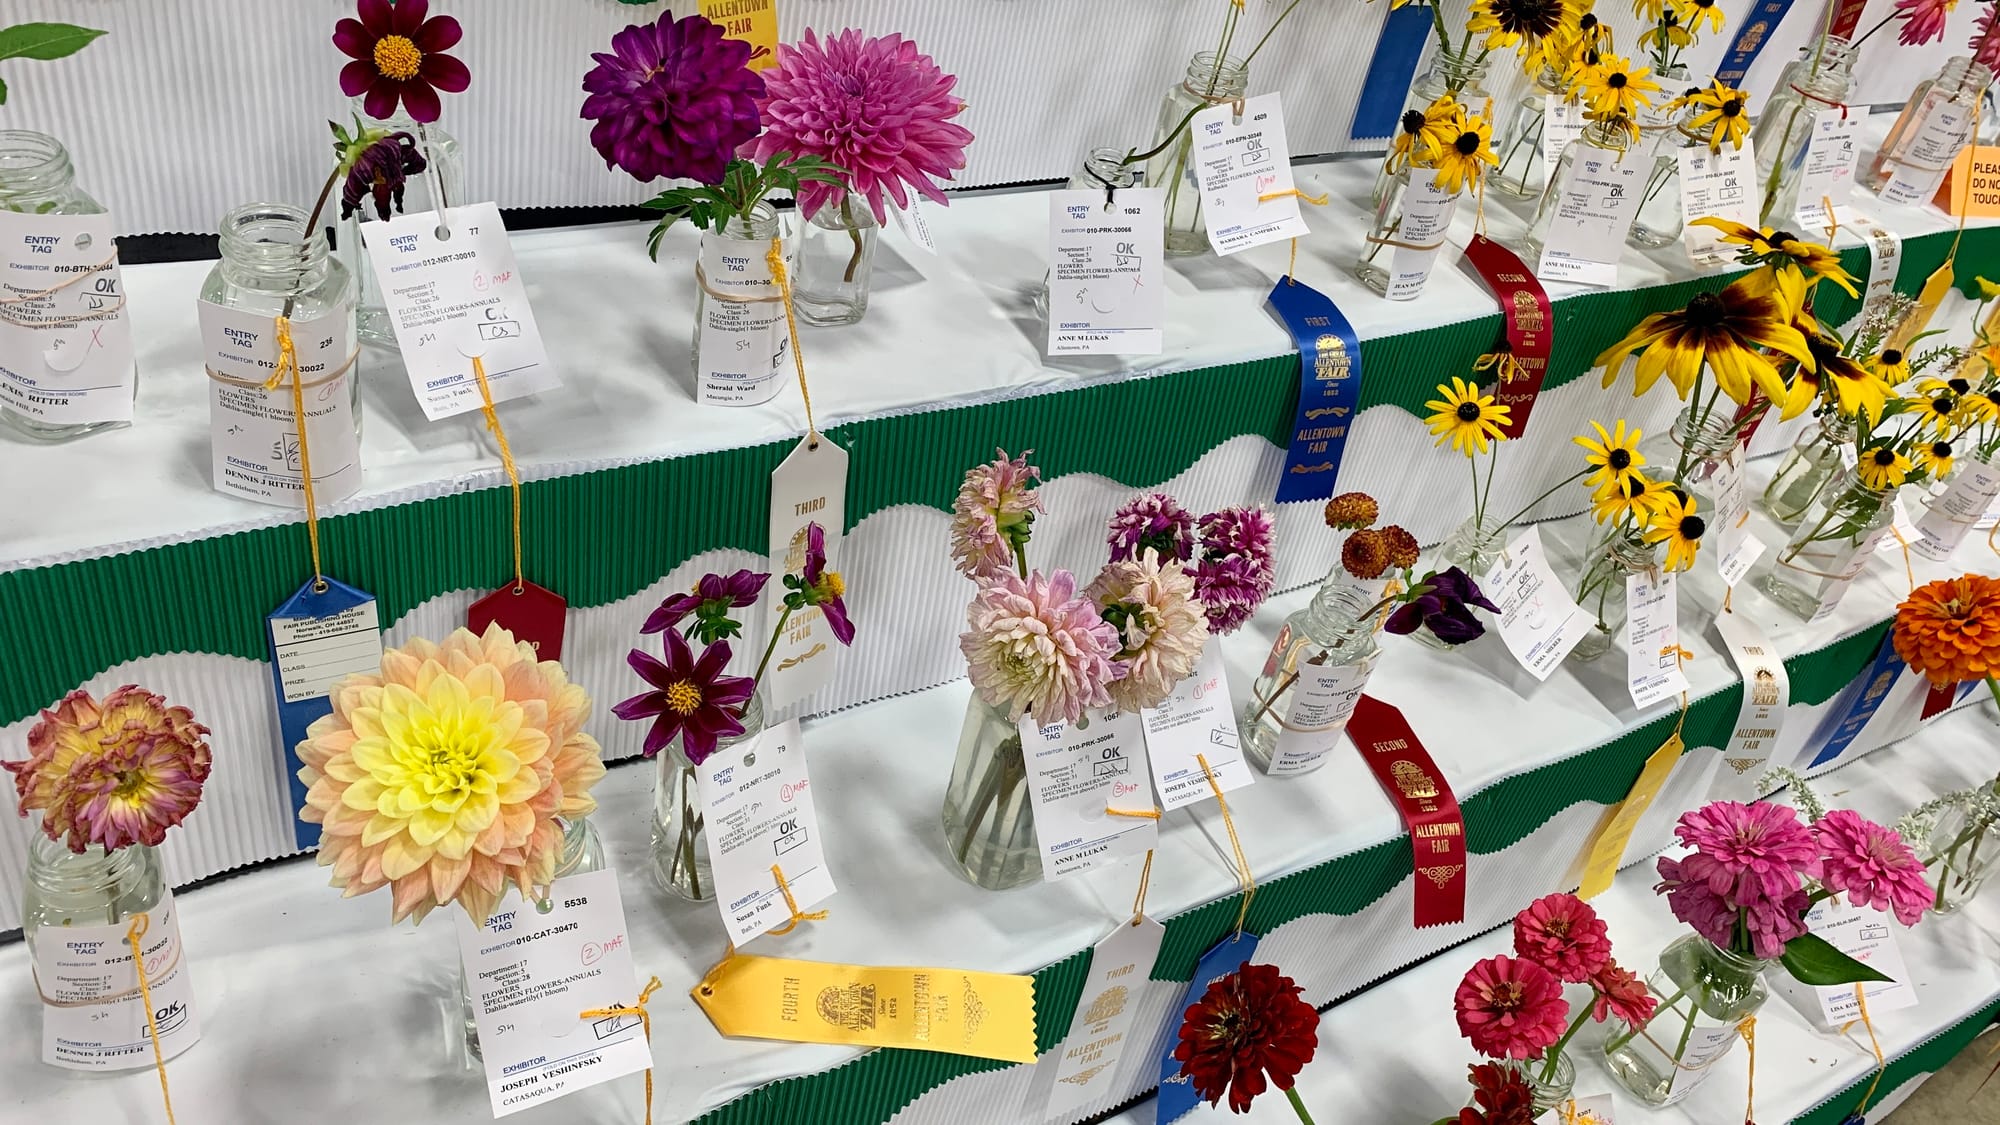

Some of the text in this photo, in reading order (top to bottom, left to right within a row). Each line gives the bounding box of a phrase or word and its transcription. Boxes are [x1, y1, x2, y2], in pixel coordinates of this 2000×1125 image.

[708, 0, 768, 19] ALLENTOWN
[1765, 3, 1781, 13] FIRST
[728, 18, 752, 36] FAIR
[1205, 121, 1223, 130] ENTRY
[1247, 139, 1263, 150] OK
[1725, 178, 1737, 187] OK
[1973, 178, 1986, 189] DO
[1611, 188, 1624, 197] OK
[1973, 193, 2000, 205] TOUC
[469, 227, 479, 236] 77
[25, 236, 60, 244] ENTRY
[390, 234, 418, 246] ENTRY
[31, 245, 52, 254] TAG
[398, 244, 416, 253] TAG
[1116, 243, 1134, 254] OK
[95, 279, 116, 293] OK
[399, 304, 431, 315] FLOWERS
[709, 311, 740, 320] FLOWERS
[709, 318, 741, 326] SPECIMEN
[1305, 317, 1331, 327] FIRST
[224, 328, 258, 341] ENTRY
[231, 337, 252, 348] TAG
[218, 352, 254, 364] EXHIBITOR
[1316, 367, 1349, 379] FAIR
[427, 374, 464, 389] EXHIBITOR
[707, 383, 732, 392] Sherald
[28, 394, 69, 406] RITTER
[219, 388, 255, 404] FLOWERS
[219, 395, 258, 411] SPECIMEN
[1298, 426, 1345, 441] ALLENTOWN
[1308, 441, 1327, 454] FAIR
[227, 456, 268, 471] EXHIBITOR
[225, 469, 259, 483] DENNIS
[269, 480, 305, 490] RITTER
[795, 496, 826, 517] THIRD
[1519, 570, 1530, 584] OK
[790, 626, 811, 645] FAIR
[1743, 646, 1764, 655] THIRD
[1753, 695, 1777, 705] FAIR
[1040, 724, 1064, 735] ENTRY
[1735, 728, 1776, 739] ALLENTOWN
[1045, 733, 1060, 741] TAG
[778, 745, 786, 754] 79
[1373, 738, 1408, 752] SECOND
[1743, 740, 1760, 749] FAIR
[1102, 747, 1120, 759] OK
[713, 765, 734, 782] ENTRY
[718, 777, 732, 787] TAG
[1041, 782, 1069, 792] FLOWERS
[1042, 786, 1072, 797] SPECIMEN
[1164, 783, 1186, 794] JOSEPH
[780, 817, 798, 834] OK
[1416, 823, 1460, 838] ALLENTOWN
[719, 827, 744, 844] FLOWERS
[720, 832, 746, 849] SPECIMEN
[1051, 838, 1083, 852] EXHIBITOR
[1432, 839, 1450, 853] FAIR
[1054, 845, 1108, 866] ANNE M LUKAS
[564, 897, 587, 909] 5538
[731, 890, 760, 910] EXHIBITOR
[736, 901, 772, 923] Susan Funk
[484, 911, 516, 927] ENTRY
[492, 922, 513, 933] TAG
[67, 941, 104, 949] ENTRY
[480, 923, 578, 955] EXHIBITOR 010-CAT-30470
[1106, 964, 1135, 980] THIRD
[482, 985, 520, 1000] FLOWERS
[484, 969, 601, 1007] SPECIMEN FLOWERS-ANNUALS
[547, 985, 569, 997] bloom)
[782, 977, 800, 1022] FOURTH
[156, 1001, 179, 1020] OK
[848, 982, 860, 1032] ALLENTOWN
[861, 984, 876, 1031] FAIR
[916, 974, 930, 1042] ALLENTOWN
[939, 994, 949, 1022] FAIR
[1830, 1005, 1844, 1013] LISA
[57, 1038, 102, 1047] EXHIBITOR
[1067, 1032, 1122, 1060] ALLENTOWN
[57, 1047, 144, 1057] DENNIS RITTER
[1080, 1050, 1103, 1064] FAIR
[503, 1056, 546, 1074] EXHIBITOR
[500, 1056, 603, 1093] JOSEPH VESHINFSKY
[503, 1082, 565, 1106] CATASAQUA, PA
